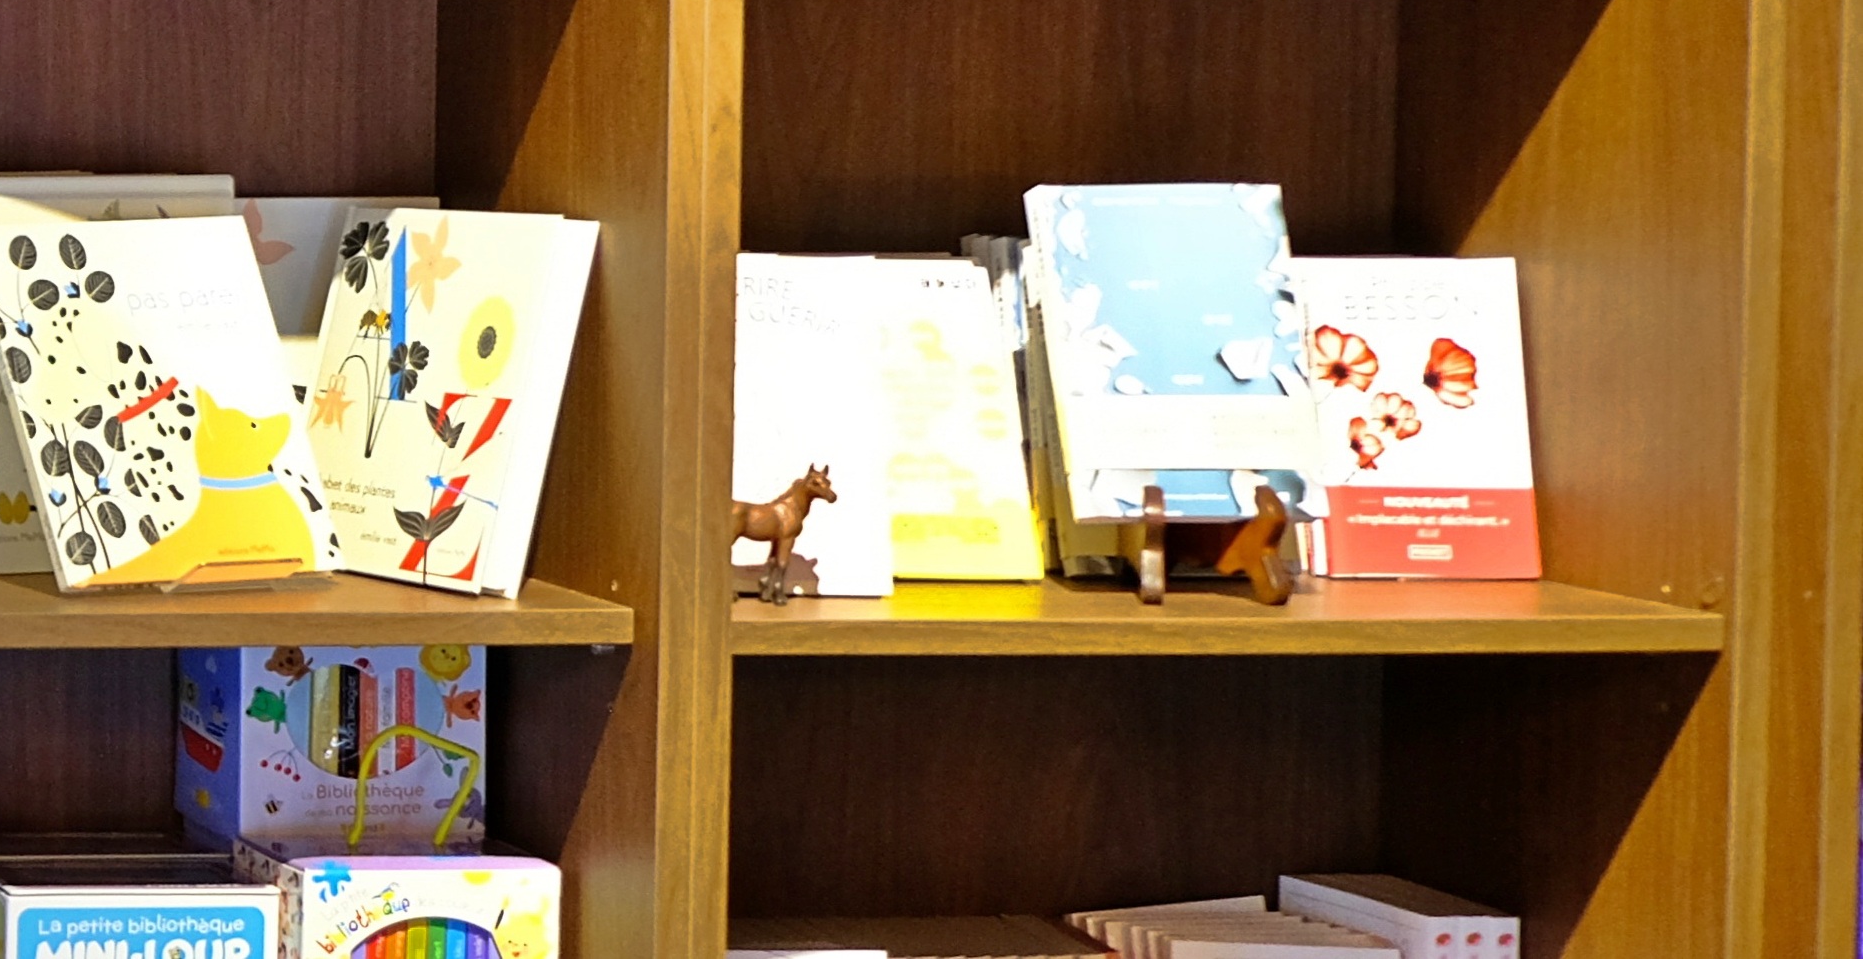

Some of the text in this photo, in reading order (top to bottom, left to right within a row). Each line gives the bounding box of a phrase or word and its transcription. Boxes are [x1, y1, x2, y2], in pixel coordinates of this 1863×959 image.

[38, 913, 245, 940] La petite bibliothèque
